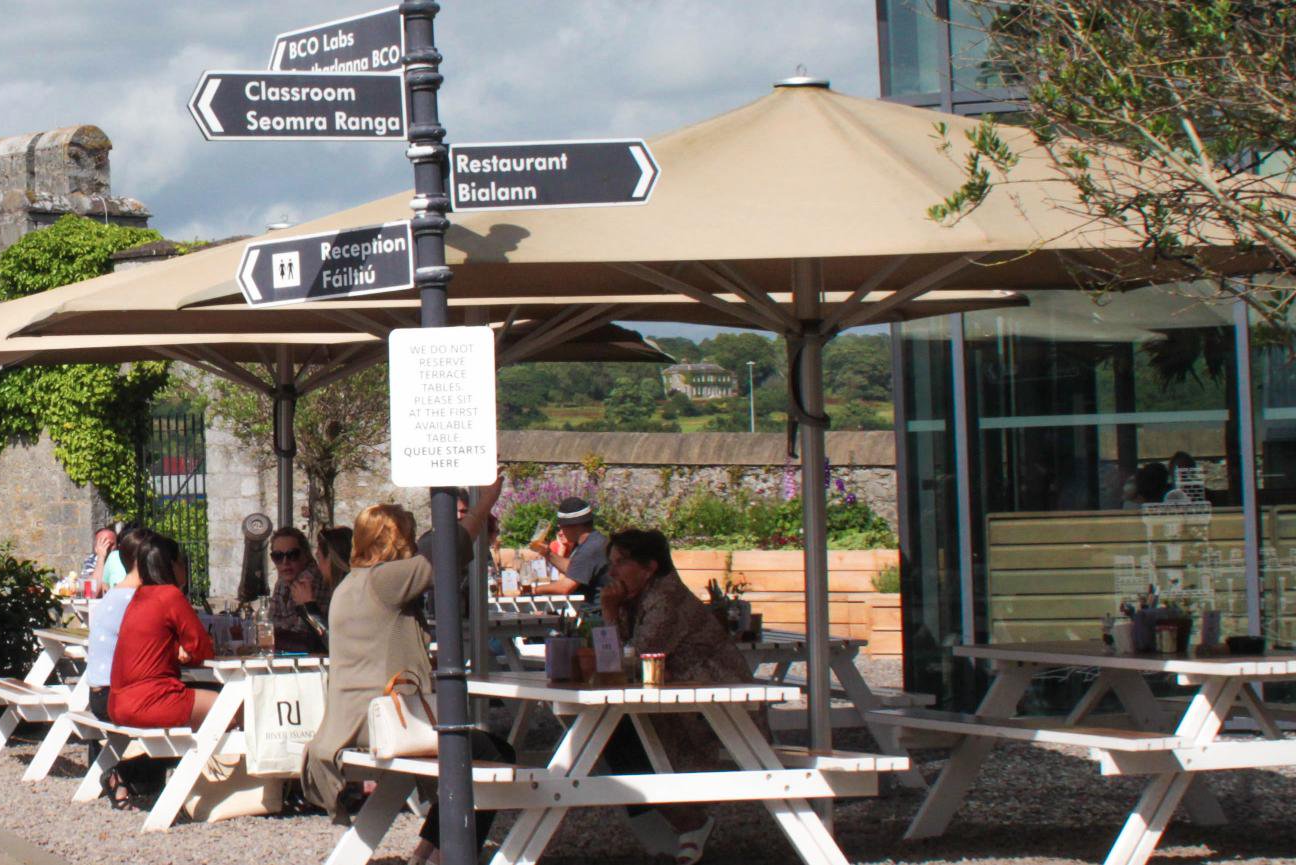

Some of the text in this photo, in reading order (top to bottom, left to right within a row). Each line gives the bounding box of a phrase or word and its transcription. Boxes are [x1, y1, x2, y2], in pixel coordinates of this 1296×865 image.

[288, 29, 355, 60] BCO Labs
[371, 45, 400, 68] BCO
[244, 80, 356, 101] Classroom
[246, 110, 400, 136] Seomra Ranga
[456, 152, 568, 174] Restaurant
[457, 181, 538, 203] Bialann
[320, 233, 406, 261] Reception
[322, 264, 376, 289] Fáiltiú
[410, 343, 474, 355] WE DO NOT
[419, 356, 466, 368] RESERVE
[419, 369, 467, 380] TERRACE
[414, 395, 473, 406] PLEASE SIT
[409, 407, 479, 417] AT THE FIRST
[415, 420, 473, 431] AVAILABLE
[403, 445, 487, 458] QUEUE STARTS
[430, 459, 460, 469] HERE
